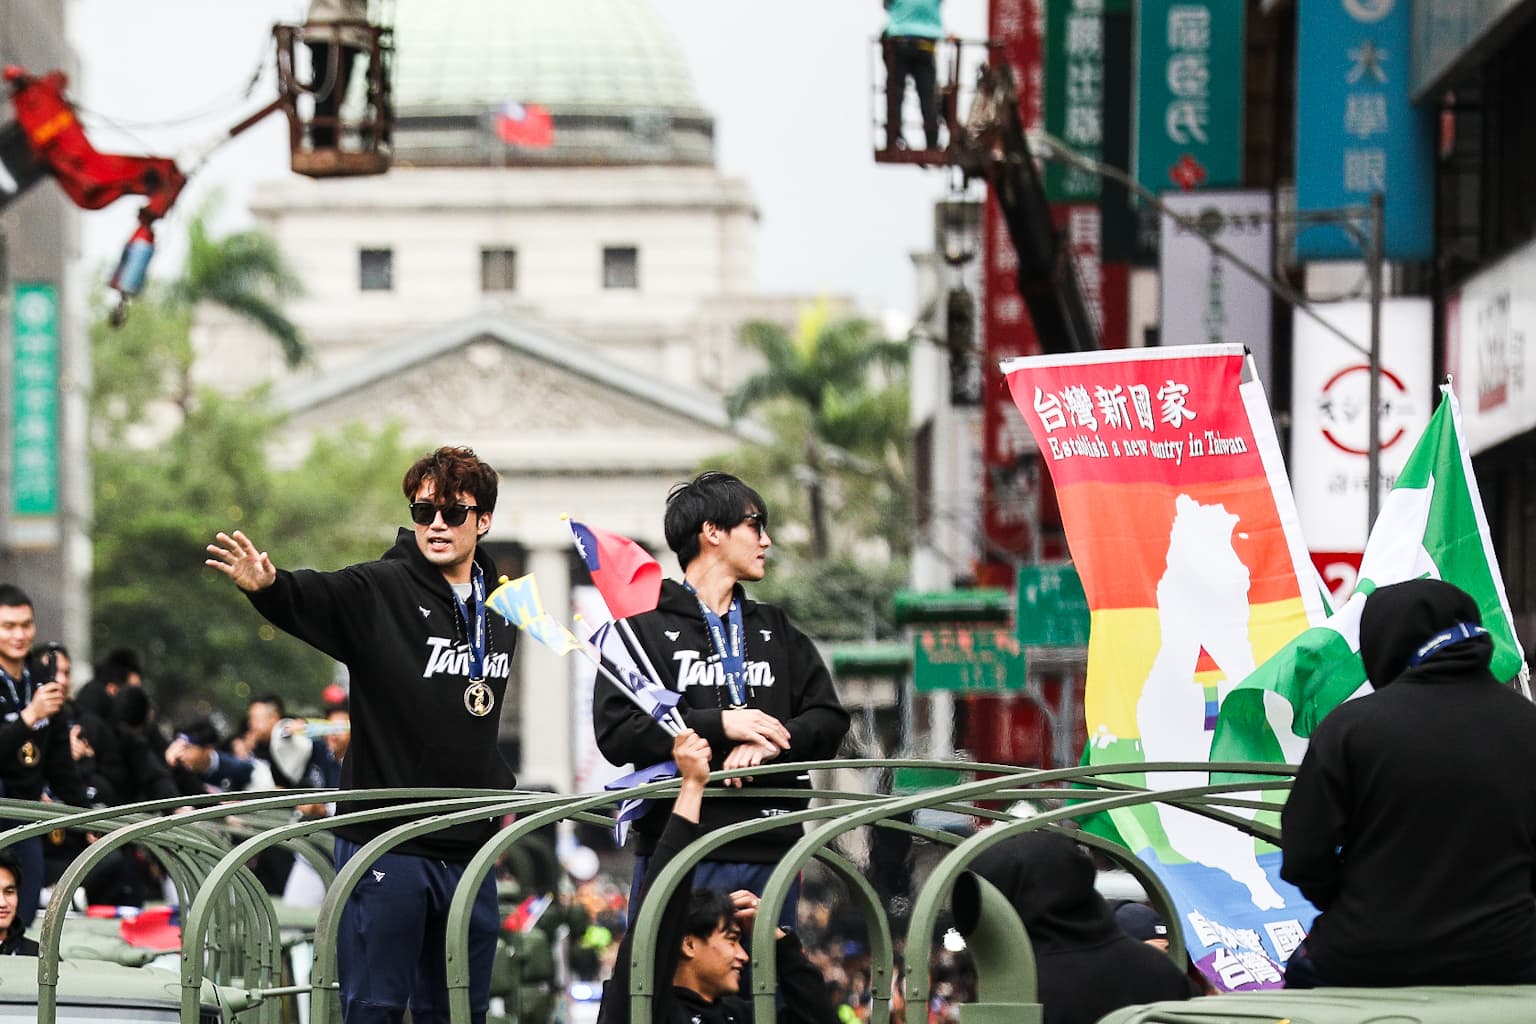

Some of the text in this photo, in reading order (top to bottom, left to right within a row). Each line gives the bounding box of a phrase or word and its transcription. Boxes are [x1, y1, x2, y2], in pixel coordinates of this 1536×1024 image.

[1167, 6, 1211, 143] 屈臣氏
[1111, 440, 1121, 457] a
[1122, 439, 1148, 457] new
[1189, 431, 1204, 457] in
[1204, 429, 1247, 456] Taiwan
